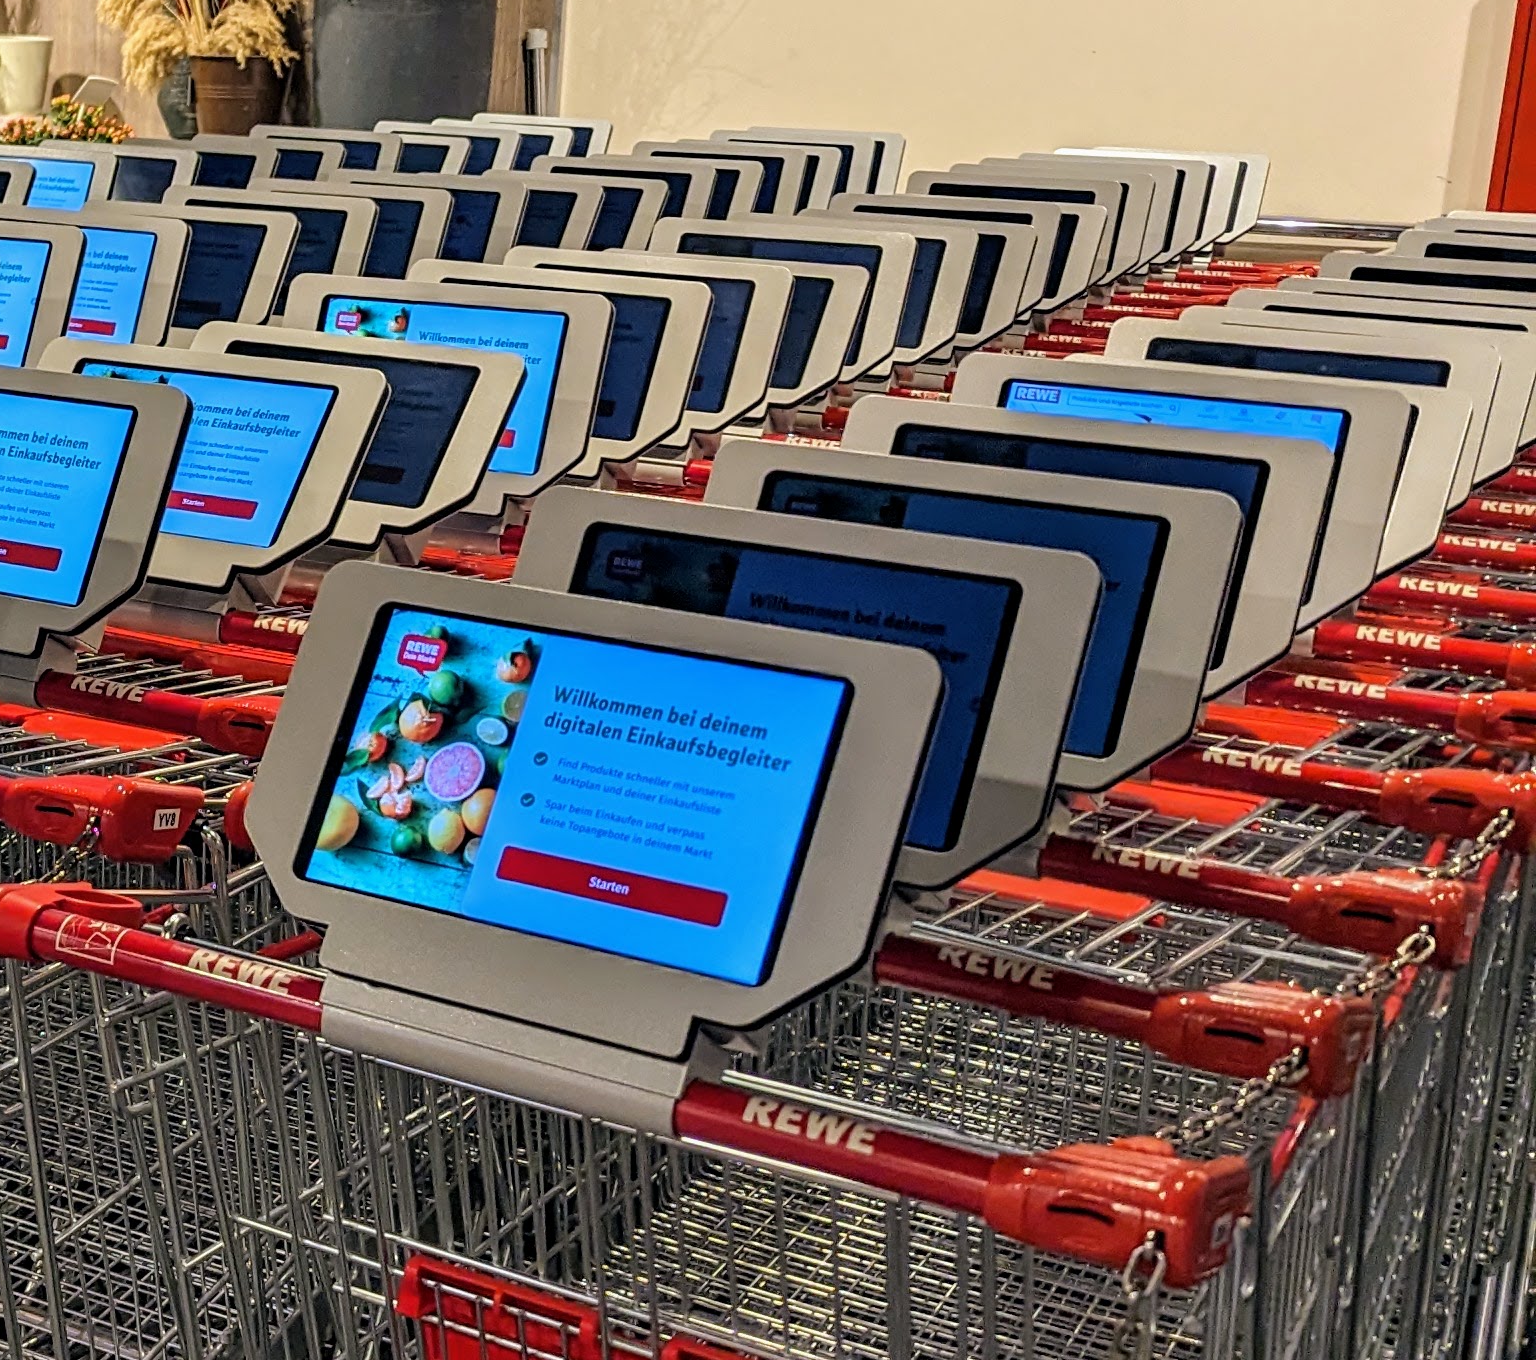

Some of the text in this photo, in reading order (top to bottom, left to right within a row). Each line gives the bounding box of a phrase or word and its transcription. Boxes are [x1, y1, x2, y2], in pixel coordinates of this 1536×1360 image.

[1016, 387, 1059, 402] REWE
[235, 407, 252, 417] bei
[252, 409, 290, 422] deinem
[32, 431, 49, 444] bei
[50, 434, 88, 450] deinem
[8, 446, 101, 469] Einkaufsbegleiter
[1481, 499, 1536, 517] REW
[1398, 575, 1479, 599] REWE
[253, 614, 310, 636] REW
[1355, 624, 1441, 650] REWE
[406, 640, 440, 656] REWE
[70, 675, 145, 703] REWE
[1293, 673, 1387, 700] REWE
[554, 685, 767, 740] Willkommen bei deinem
[544, 712, 792, 772] digitalen Einkaufsbegleiter
[558, 757, 579, 770] Find
[580, 763, 623, 778] Produkte
[626, 771, 671, 788] schneller
[673, 780, 690, 792] mit
[1202, 750, 1302, 776] REWE
[553, 774, 601, 791] Marktplan
[603, 783, 623, 795] und
[624, 788, 657, 803] deiner
[544, 800, 567, 812] Spar
[569, 804, 593, 816] beim
[596, 810, 643, 828] Einkaufen
[646, 820, 665, 831] und
[539, 815, 566, 828] keine
[568, 821, 630, 841] Topangebote
[633, 833, 642, 844] in
[683, 845, 713, 859] Markt
[1092, 845, 1202, 879] REWE
[589, 877, 629, 895] Starten
[188, 948, 292, 995] REWE
[937, 945, 1055, 991] REWE
[742, 1095, 877, 1156] REWE
